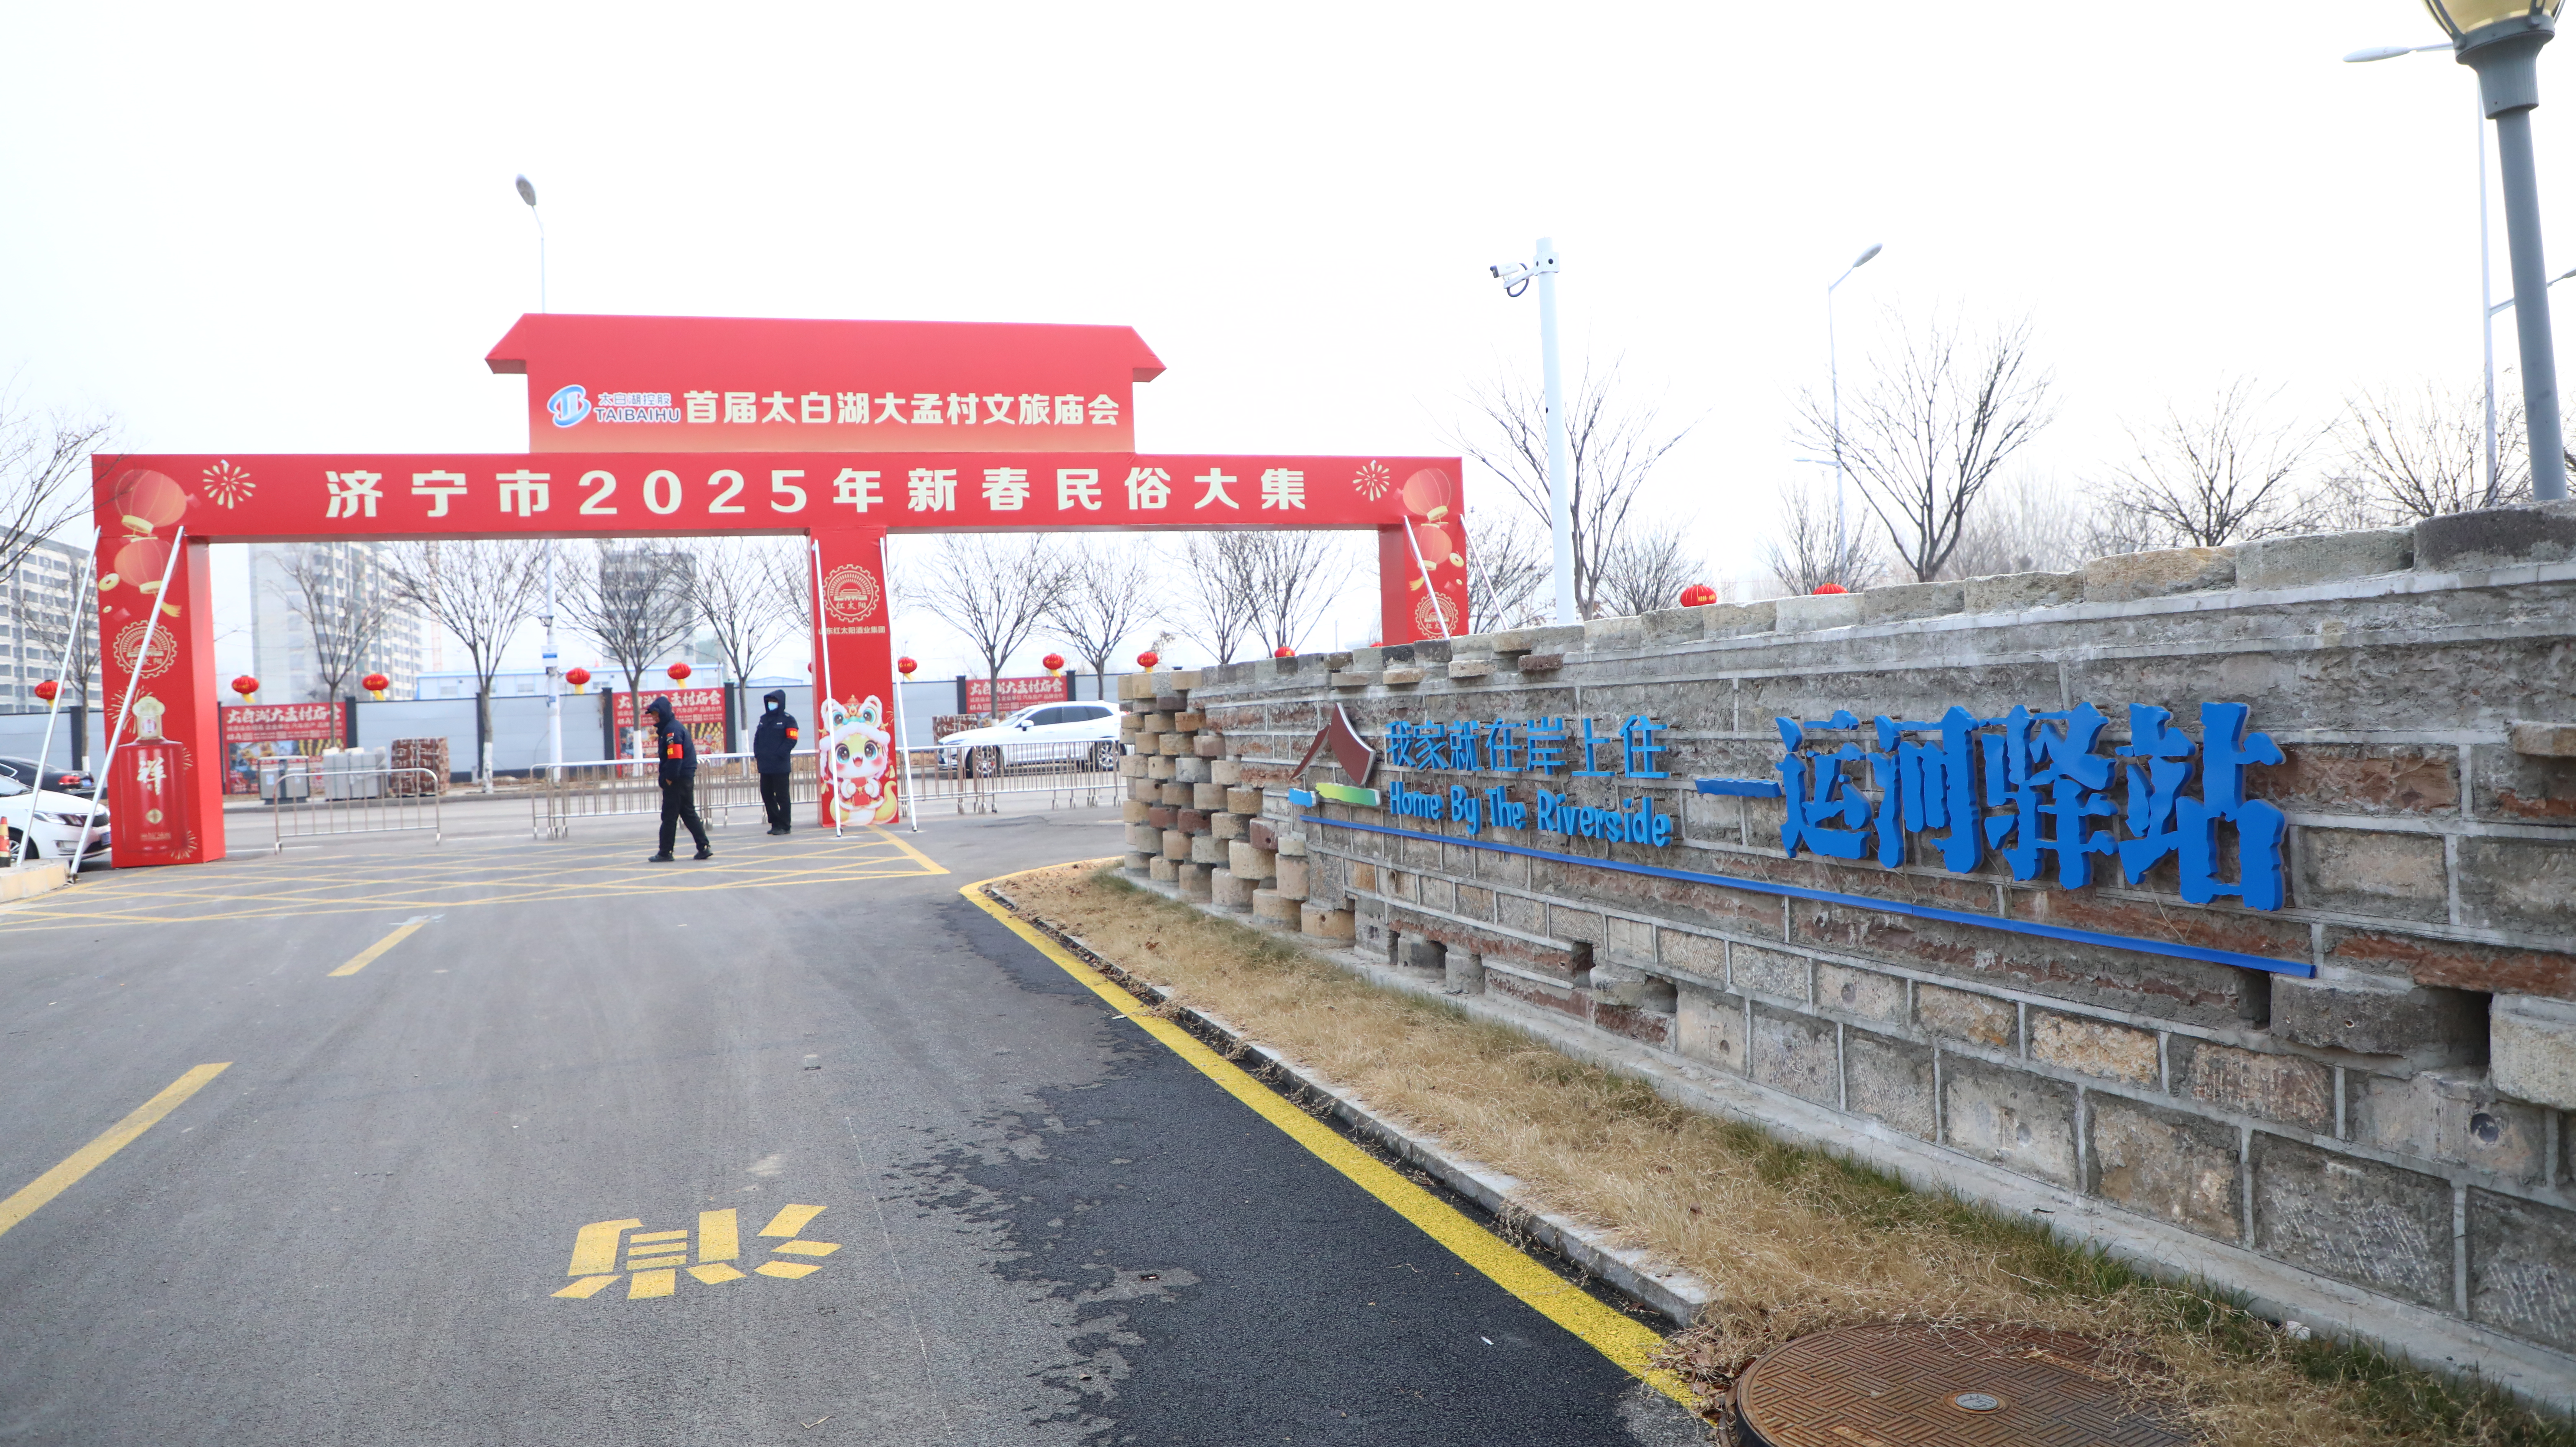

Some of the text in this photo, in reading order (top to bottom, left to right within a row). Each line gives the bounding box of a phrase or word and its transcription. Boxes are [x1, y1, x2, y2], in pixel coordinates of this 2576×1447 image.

[598, 393, 671, 405] 太白湖控股
[683, 391, 1119, 425] 首届太白湖大孟村文旅庙会
[595, 409, 681, 422] TAIBAIHU
[836, 601, 866, 610] 红太阳
[618, 689, 721, 709] 太湖孟村庙会
[1385, 714, 1670, 778] 我家就在岸上住
[1389, 781, 1672, 847] Home By The Riverside
